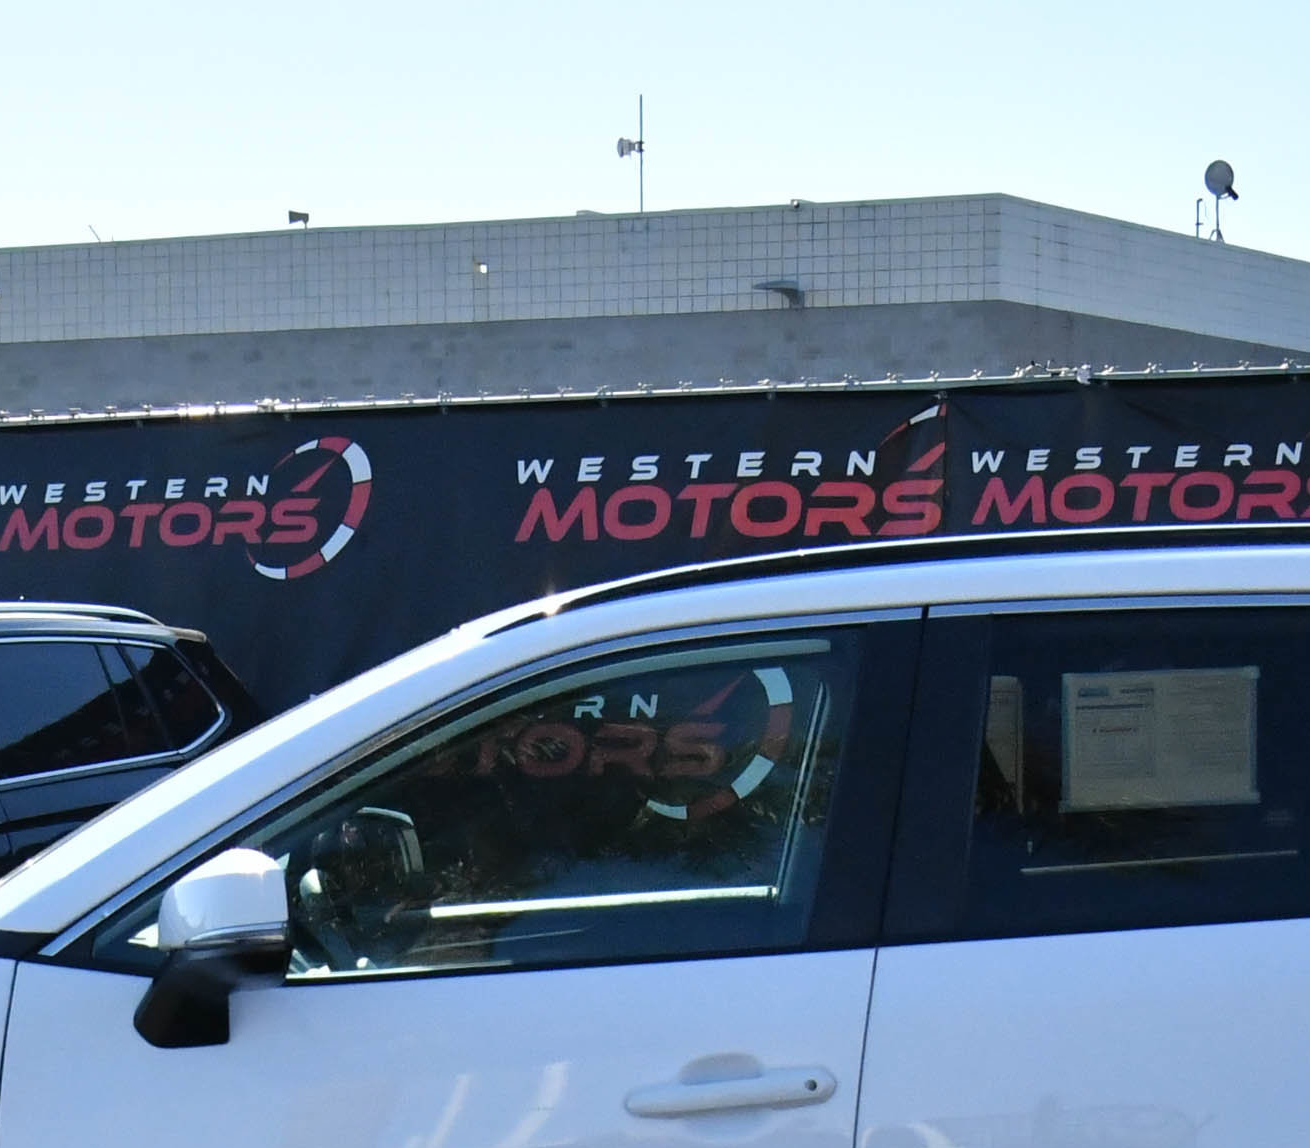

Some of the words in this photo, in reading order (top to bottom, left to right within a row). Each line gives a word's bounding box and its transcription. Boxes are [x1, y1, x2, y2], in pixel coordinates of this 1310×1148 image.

[518, 450, 876, 485] WESTERN
[972, 441, 1303, 474] WESTERN
[0, 474, 269, 505] WESTERN
[515, 479, 944, 542] MOTORS
